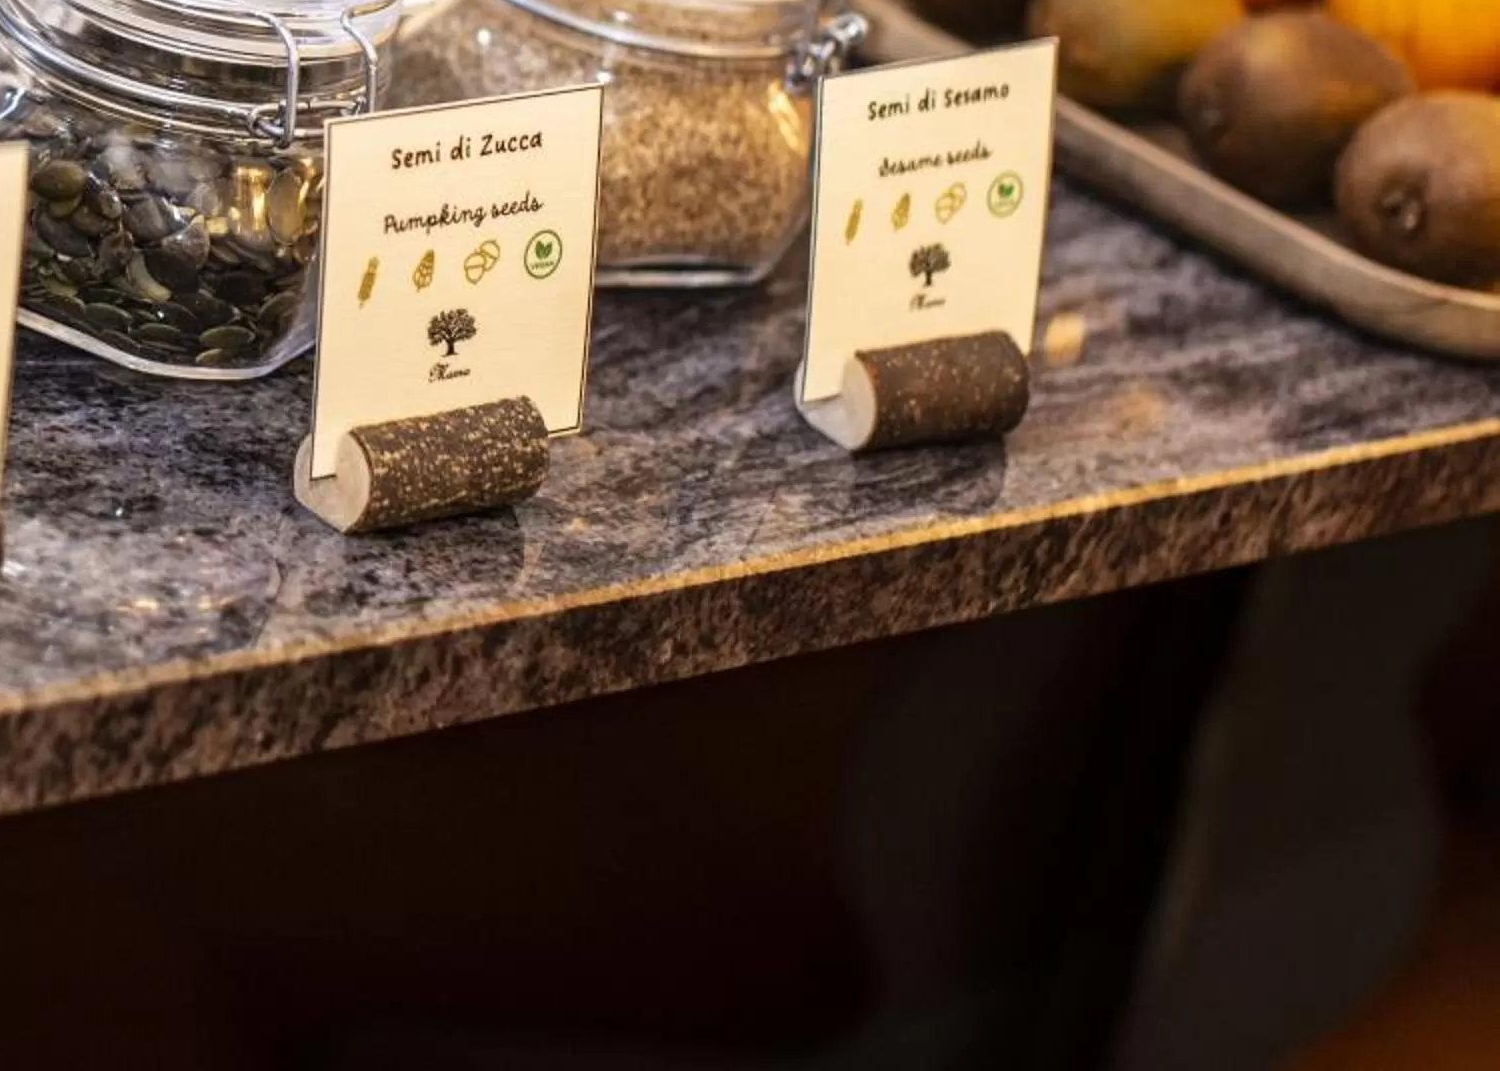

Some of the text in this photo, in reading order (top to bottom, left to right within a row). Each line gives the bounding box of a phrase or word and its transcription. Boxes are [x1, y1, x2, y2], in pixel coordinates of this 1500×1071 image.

[868, 83, 1010, 121] Semi di Sesamo
[391, 131, 543, 170] Semi di Zucca
[879, 139, 993, 177] Sesame seeds
[383, 189, 544, 236] Pumpking seeds
